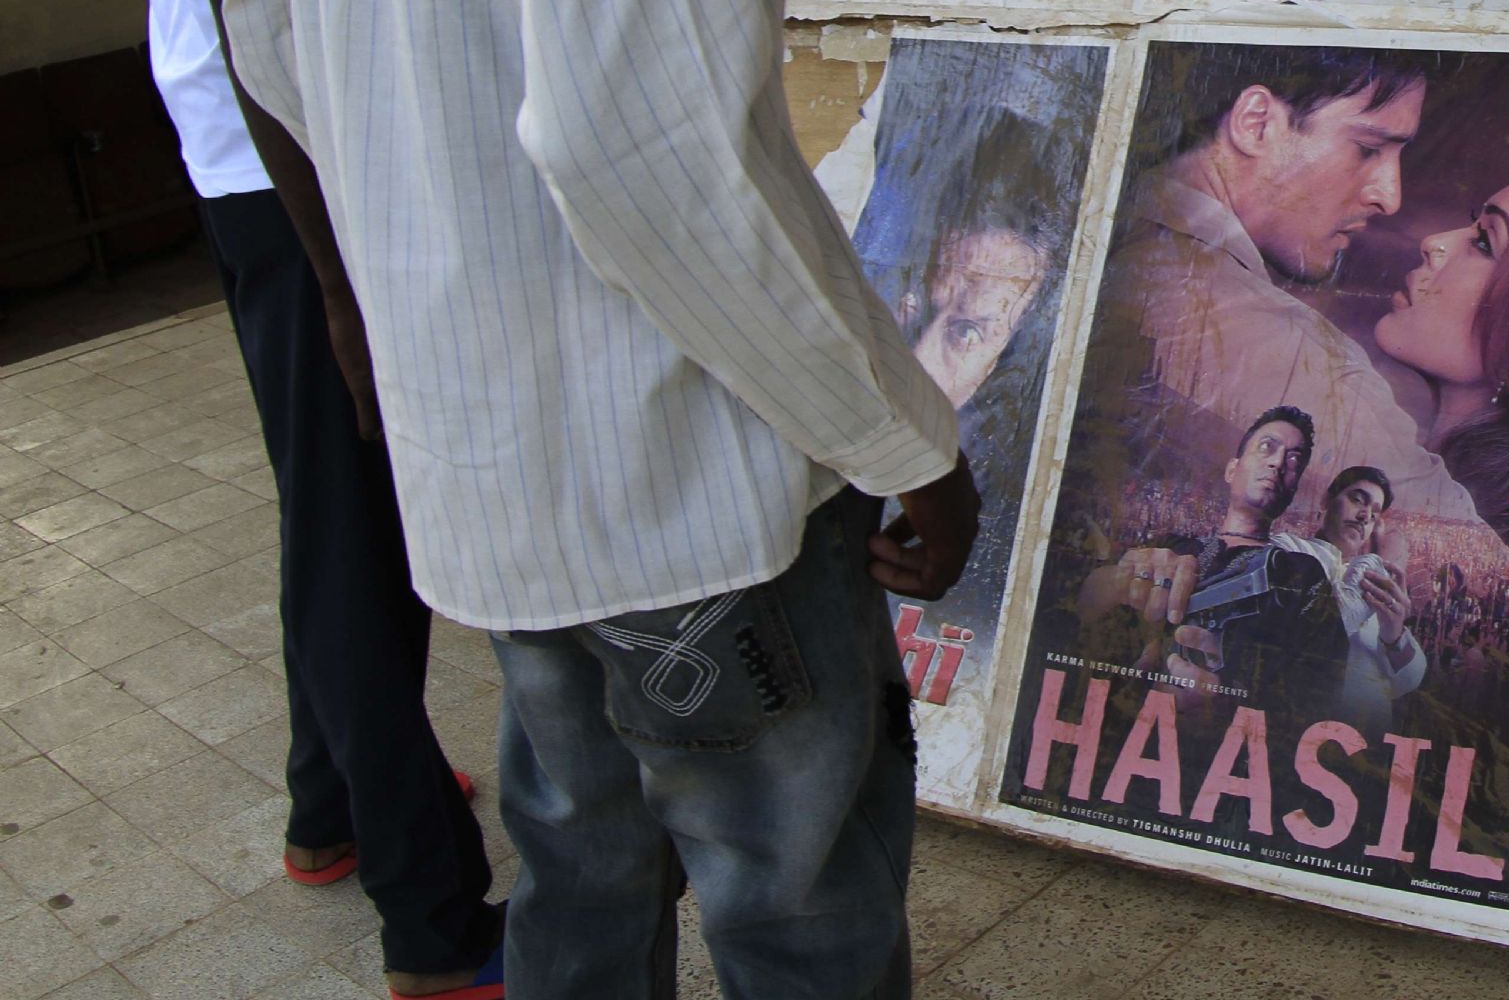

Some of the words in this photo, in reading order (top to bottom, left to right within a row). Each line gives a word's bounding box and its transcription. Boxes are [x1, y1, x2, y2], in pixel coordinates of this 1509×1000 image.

[1046, 651, 1085, 668] KARMA
[1088, 660, 1143, 680] NETWORK
[1147, 671, 1196, 689] LIMITED
[1023, 668, 1506, 881] HAASIL
[1070, 806, 1115, 823] DIRECTED
[1116, 817, 1129, 826] BY
[1132, 818, 1202, 842] TIGMANSHU
[1206, 835, 1251, 853] DHULIA
[1260, 847, 1292, 861] MUSIC
[1294, 853, 1374, 878] JATIN-LALIT
[1410, 878, 1481, 898] indiatimes.com
